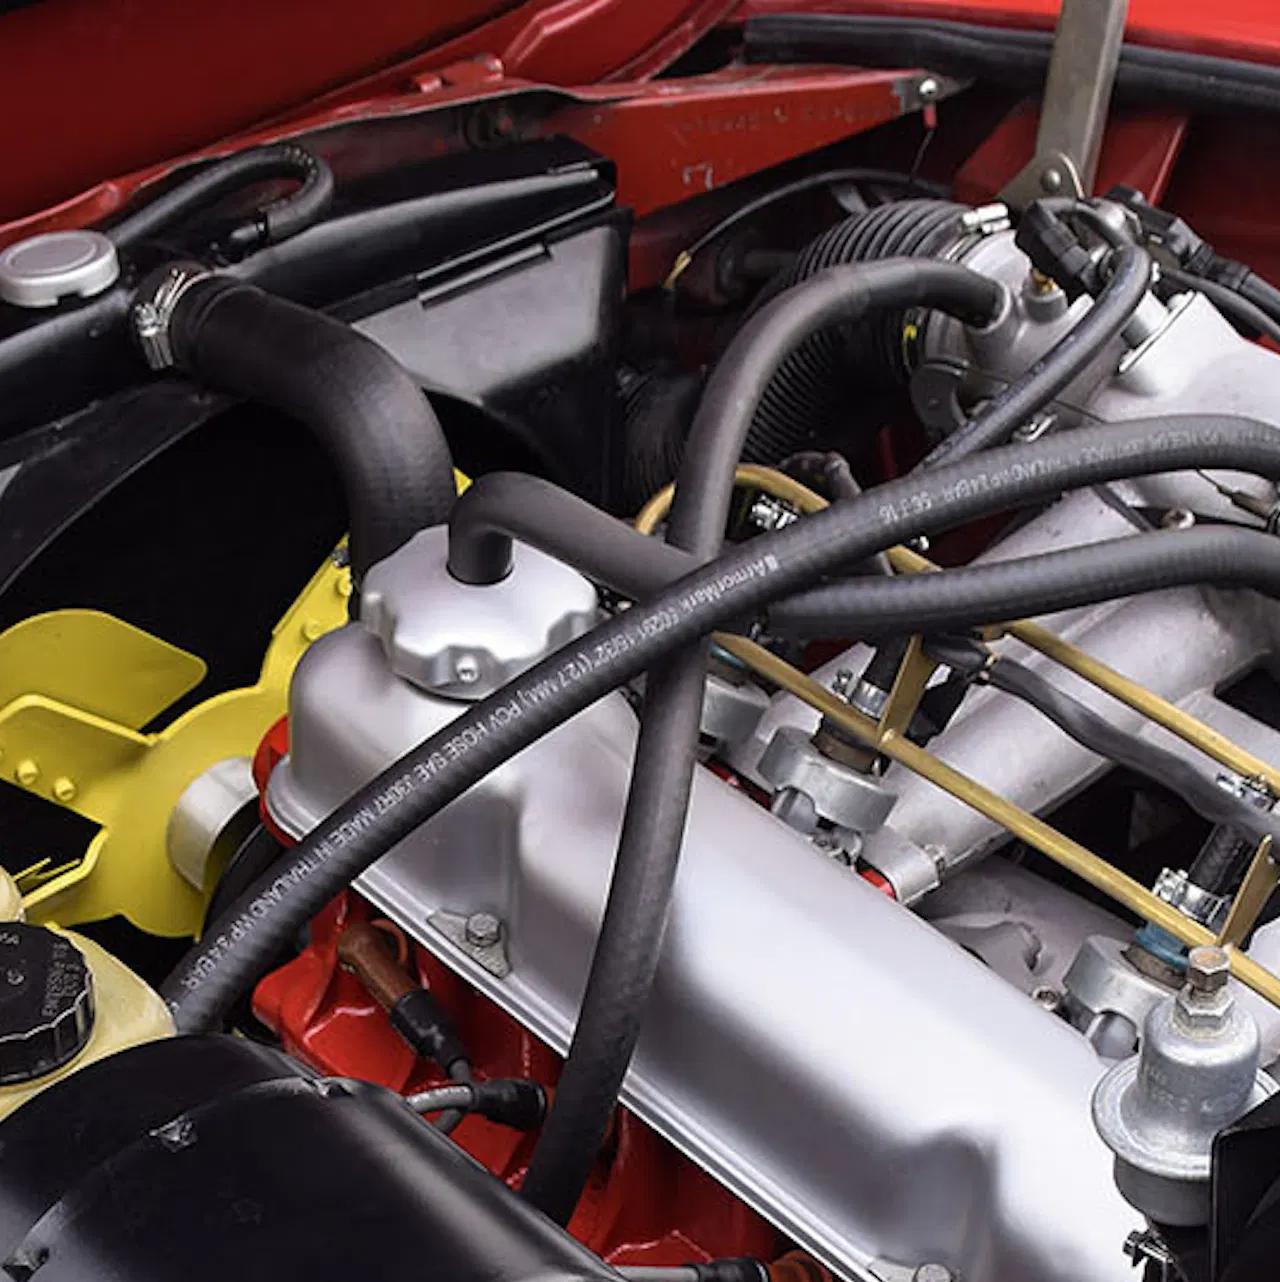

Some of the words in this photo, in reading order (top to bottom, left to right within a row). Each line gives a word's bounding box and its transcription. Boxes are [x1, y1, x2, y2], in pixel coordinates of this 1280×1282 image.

[441, 719, 489, 761] HOSE
[413, 750, 448, 783] SAE
[328, 805, 375, 848] MADE
[313, 839, 335, 861] IN
[247, 855, 317, 919] THAILAND
